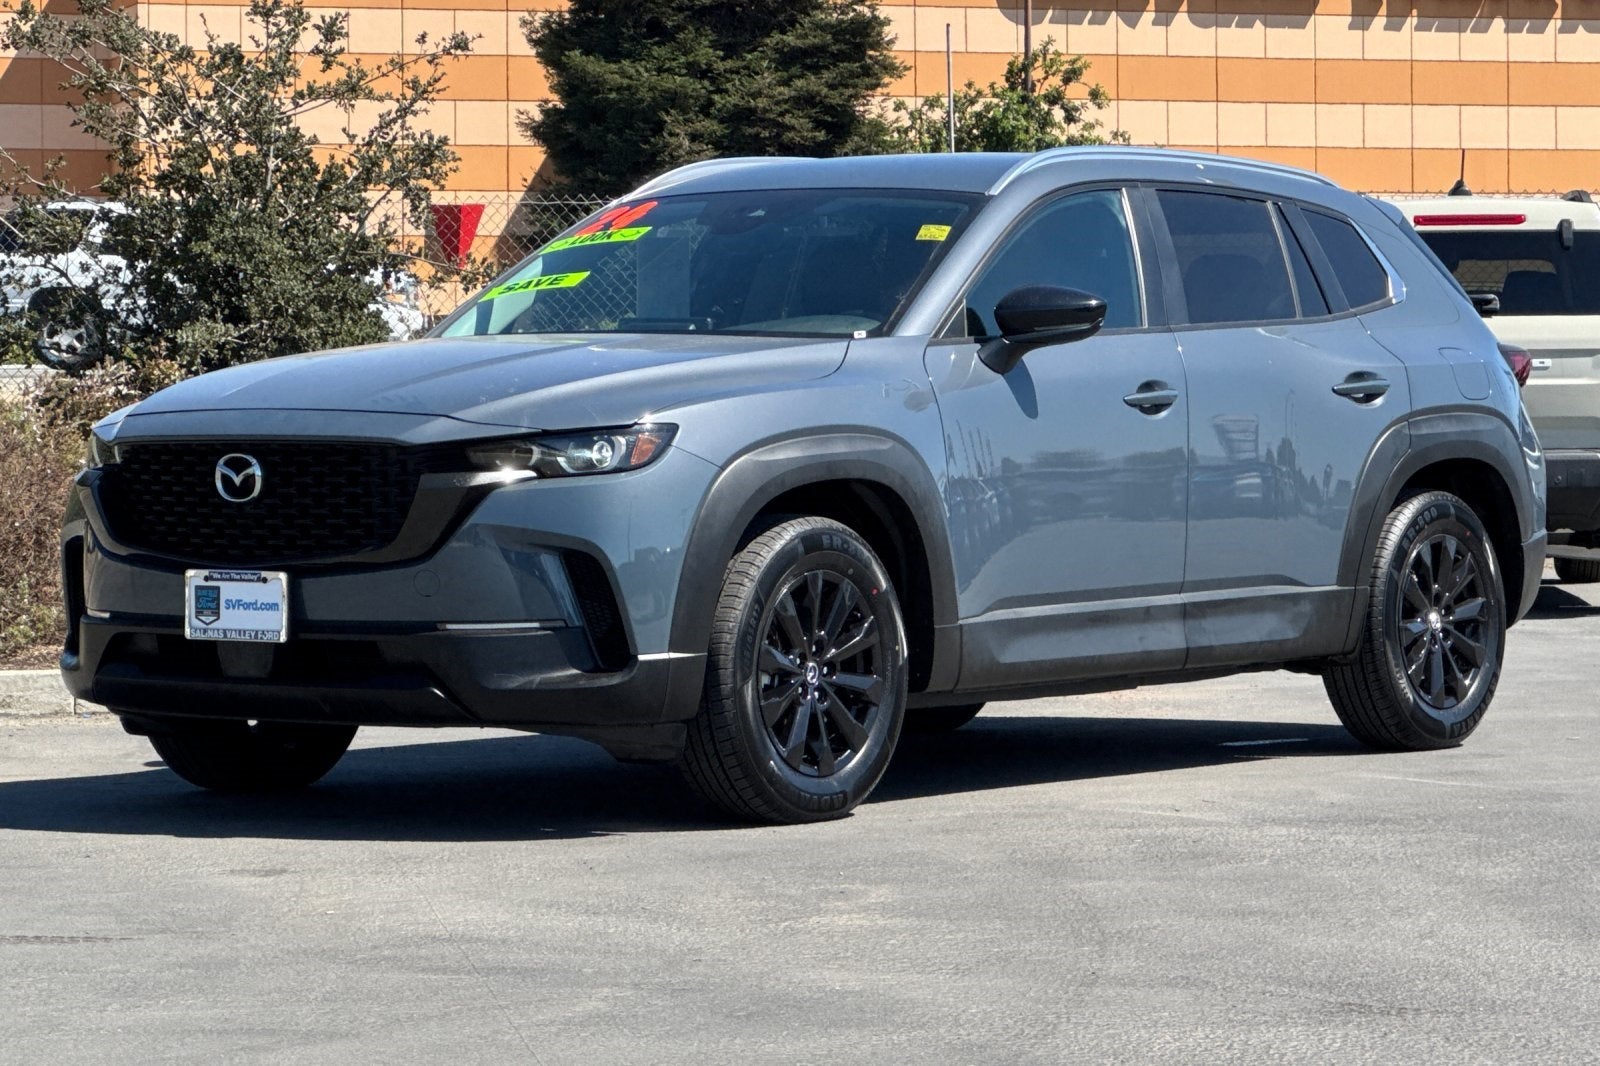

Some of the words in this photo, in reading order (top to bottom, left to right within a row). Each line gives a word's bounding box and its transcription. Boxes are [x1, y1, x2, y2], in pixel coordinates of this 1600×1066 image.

[568, 230, 618, 247] LOOK
[498, 274, 570, 295] SAVE
[224, 599, 279, 611] SVFord.com
[226, 630, 256, 639] VALLEY
[258, 631, 279, 640] FORD
